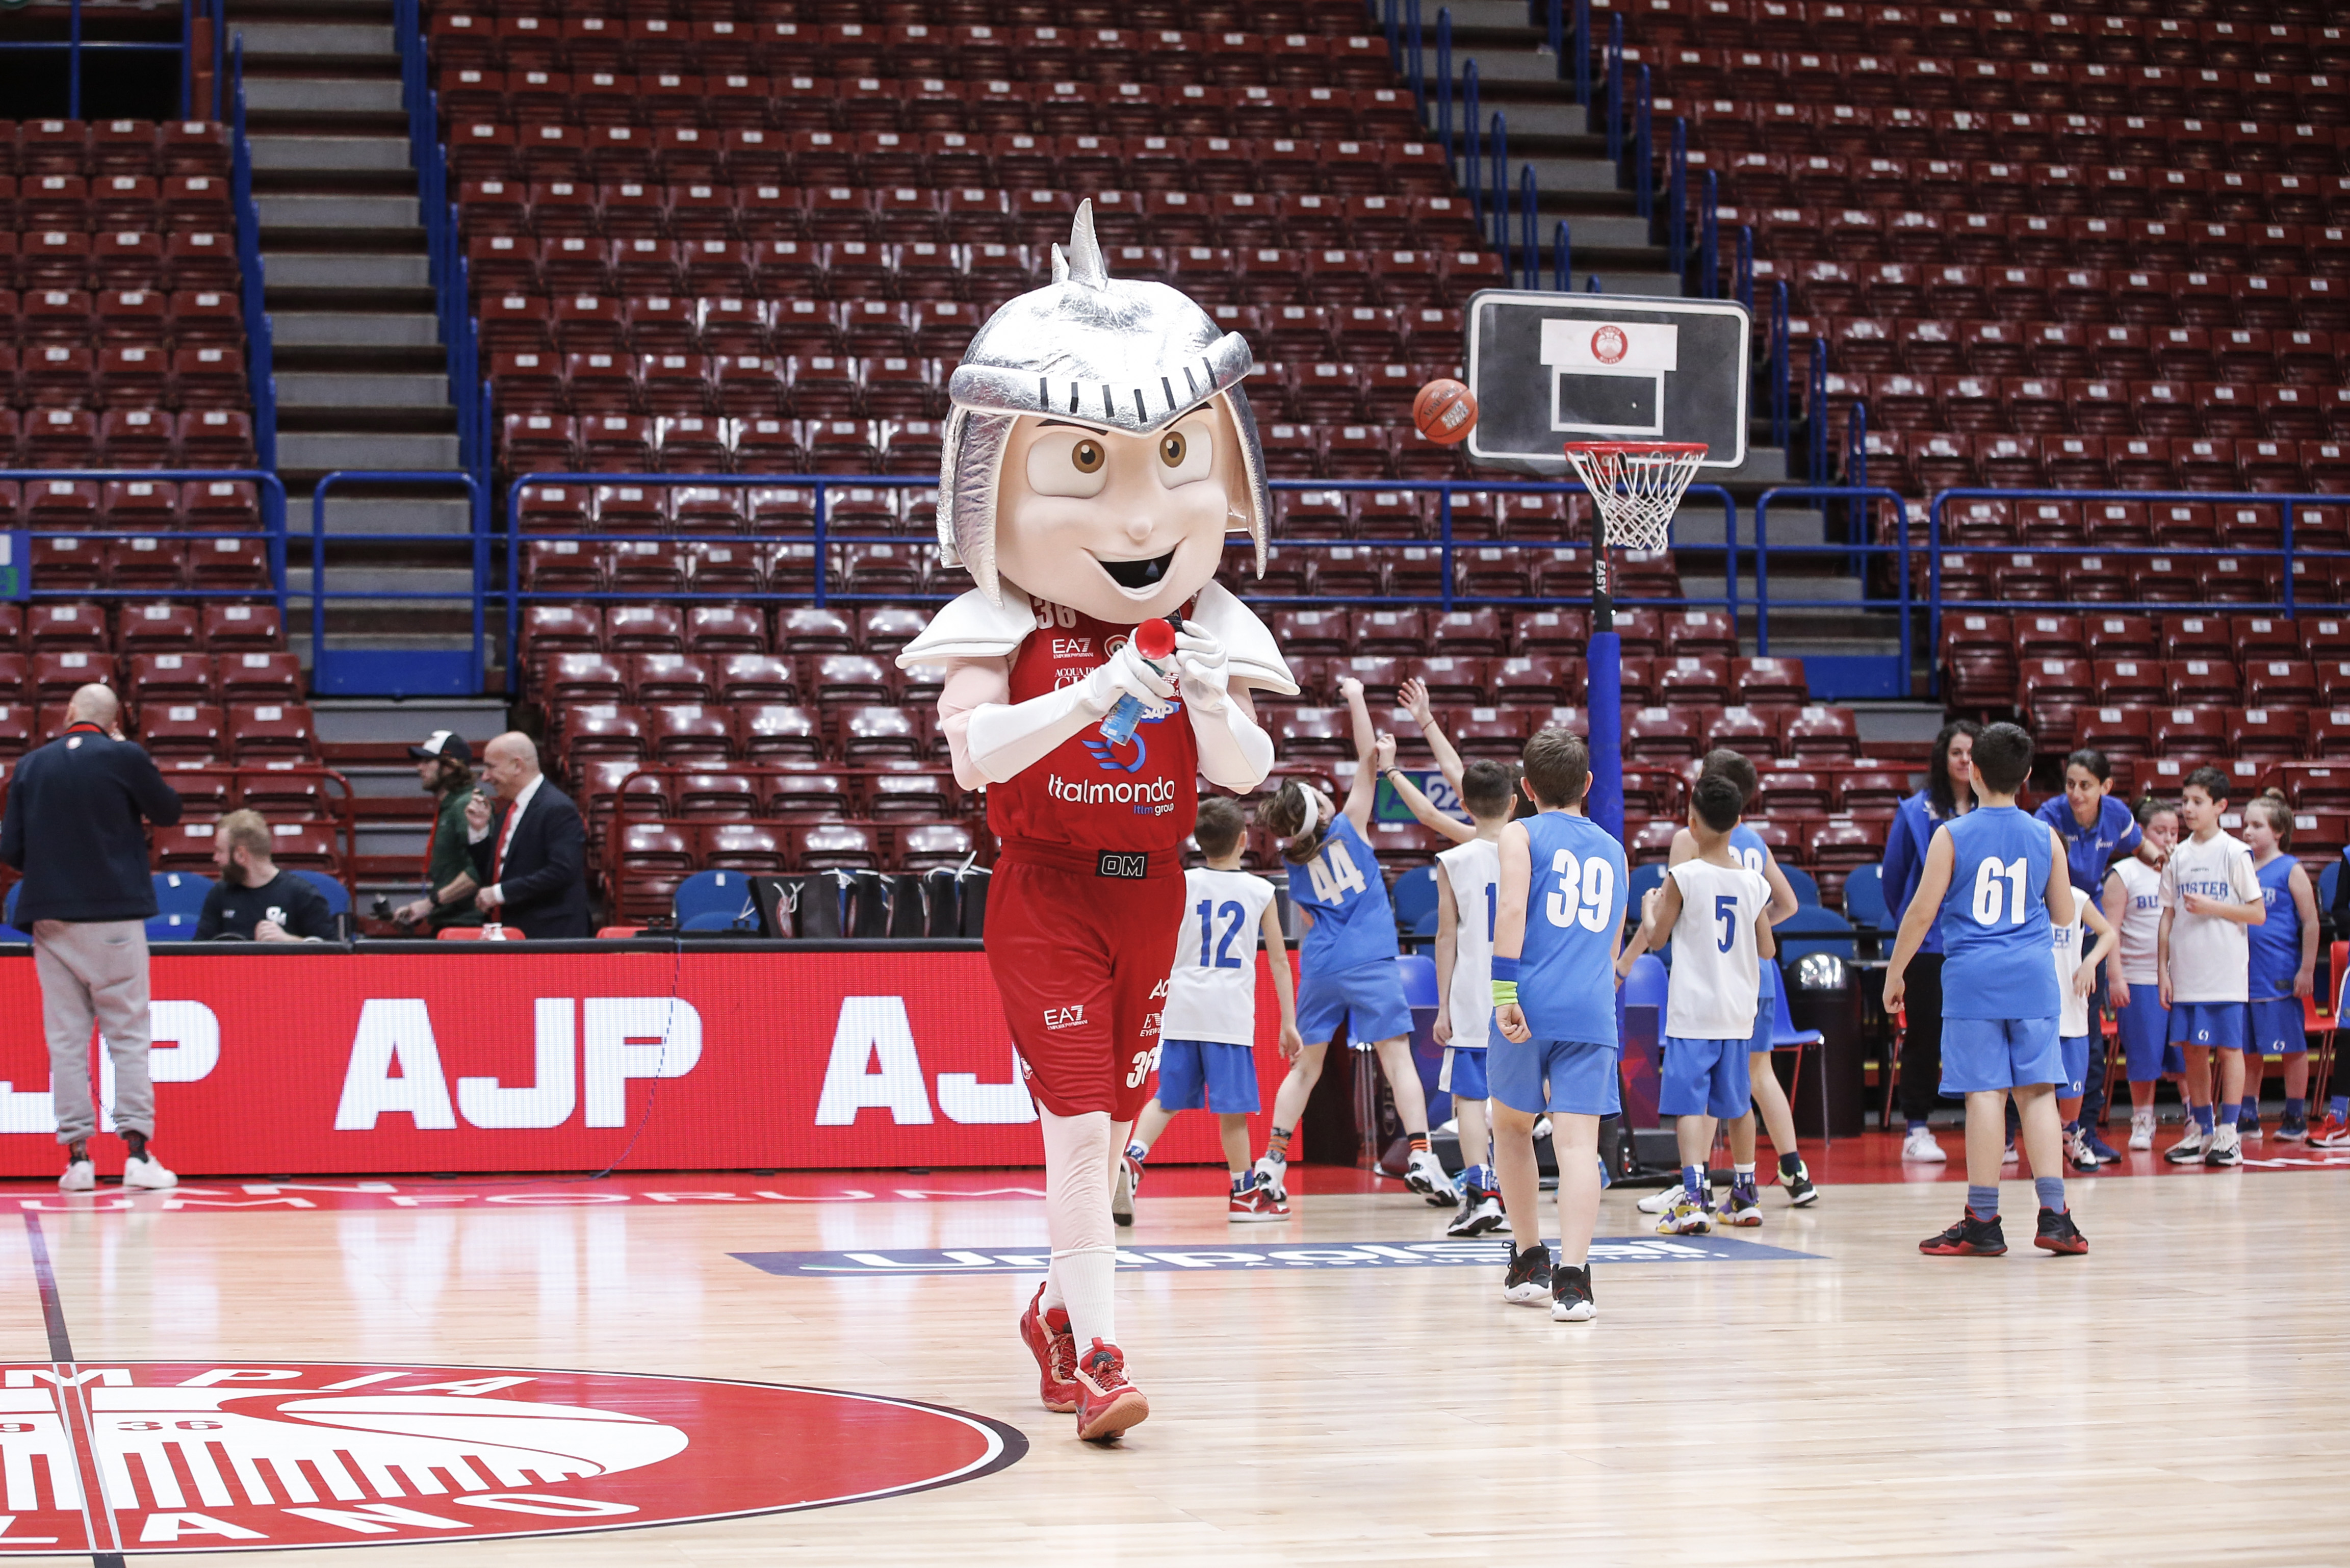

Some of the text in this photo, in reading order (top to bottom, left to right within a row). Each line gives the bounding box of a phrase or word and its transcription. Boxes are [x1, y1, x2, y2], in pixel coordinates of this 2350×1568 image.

[1596, 560, 1606, 595] EASY
[1034, 596, 1077, 629] 36
[1052, 638, 1091, 654] EA7
[1054, 667, 1084, 678] ACQUA
[1141, 704, 1174, 719] SAP
[1048, 774, 1175, 805] Italmondo
[1155, 803, 1174, 816] group
[1102, 855, 1145, 877] OM
[1307, 839, 1367, 906] 44
[1546, 849, 1614, 933] 39
[1972, 856, 2027, 926] 61
[1196, 899, 1245, 969] 12
[1715, 895, 1738, 954] 5
[1044, 1005, 1084, 1026] EA7
[333, 996, 703, 1130] AJP
[386, 1188, 1048, 1207] FORUM
[1244, 1253, 1732, 1268] ASSICURIONI
[116, 1420, 224, 1431] 36
